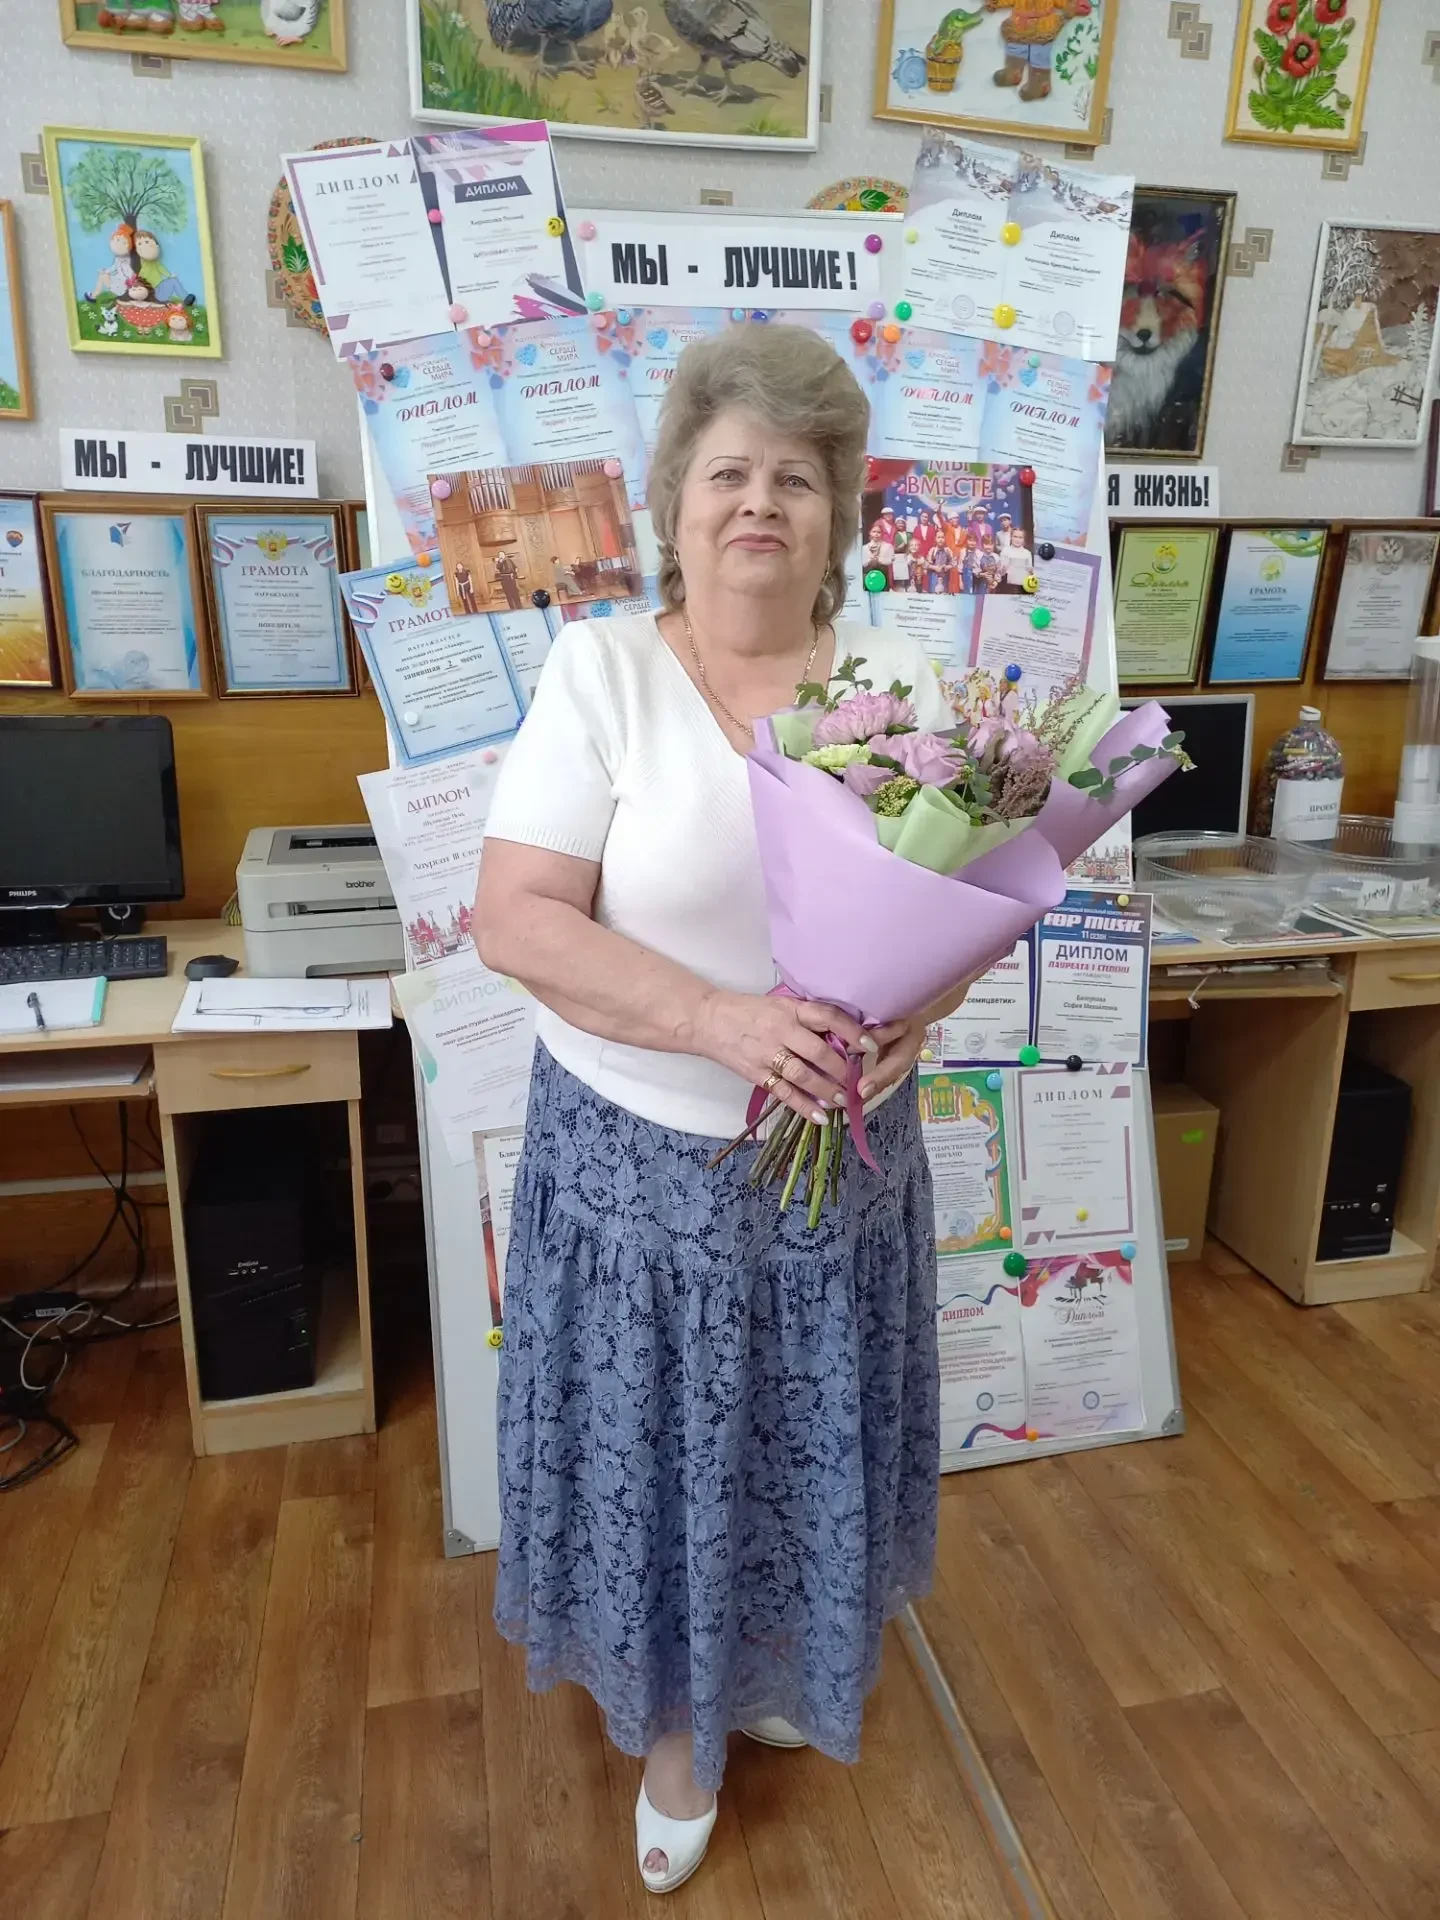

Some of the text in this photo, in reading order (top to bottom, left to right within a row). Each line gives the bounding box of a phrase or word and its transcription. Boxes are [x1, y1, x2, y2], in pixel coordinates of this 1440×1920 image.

[314, 173, 401, 197] ДИПЛОМ
[465, 181, 519, 198] ДИПЛОМ
[951, 207, 983, 221] Диплом
[1050, 230, 1081, 242] Диплом
[611, 242, 857, 291] МЫ - ЛУЧШИЕ!
[556, 352, 580, 362] МИРА
[520, 374, 603, 400] ДИПЛОМ
[901, 385, 974, 405] ДИПЛОМ
[396, 391, 481, 423] ДИПЛОМ
[1010, 400, 1081, 428] ДИПЛОМ
[74, 438, 305, 485] МЫ - ЛУЧШИЕ!
[906, 475, 993, 499] ВМЕСТЕ
[1134, 474, 1210, 507] ЖИЗНЬ!
[81, 567, 171, 579] БЛАГОДАРНОСТЬ
[241, 564, 310, 578] ГРАМОТА
[388, 606, 454, 634] ГРАМОТ
[407, 786, 471, 814] ДИПЛОМ
[8, 890, 37, 898] PHILIPS
[345, 879, 377, 890] brother
[1043, 912, 1145, 934] TOP MUSIC
[1081, 931, 1089, 939] 11
[1056, 943, 1129, 962] ДИПЛОМ
[433, 978, 512, 1014] ДИПЛОМ
[1033, 1088, 1104, 1104] ДИПЛОМ
[942, 1306, 985, 1323] ДИПЛОМ
